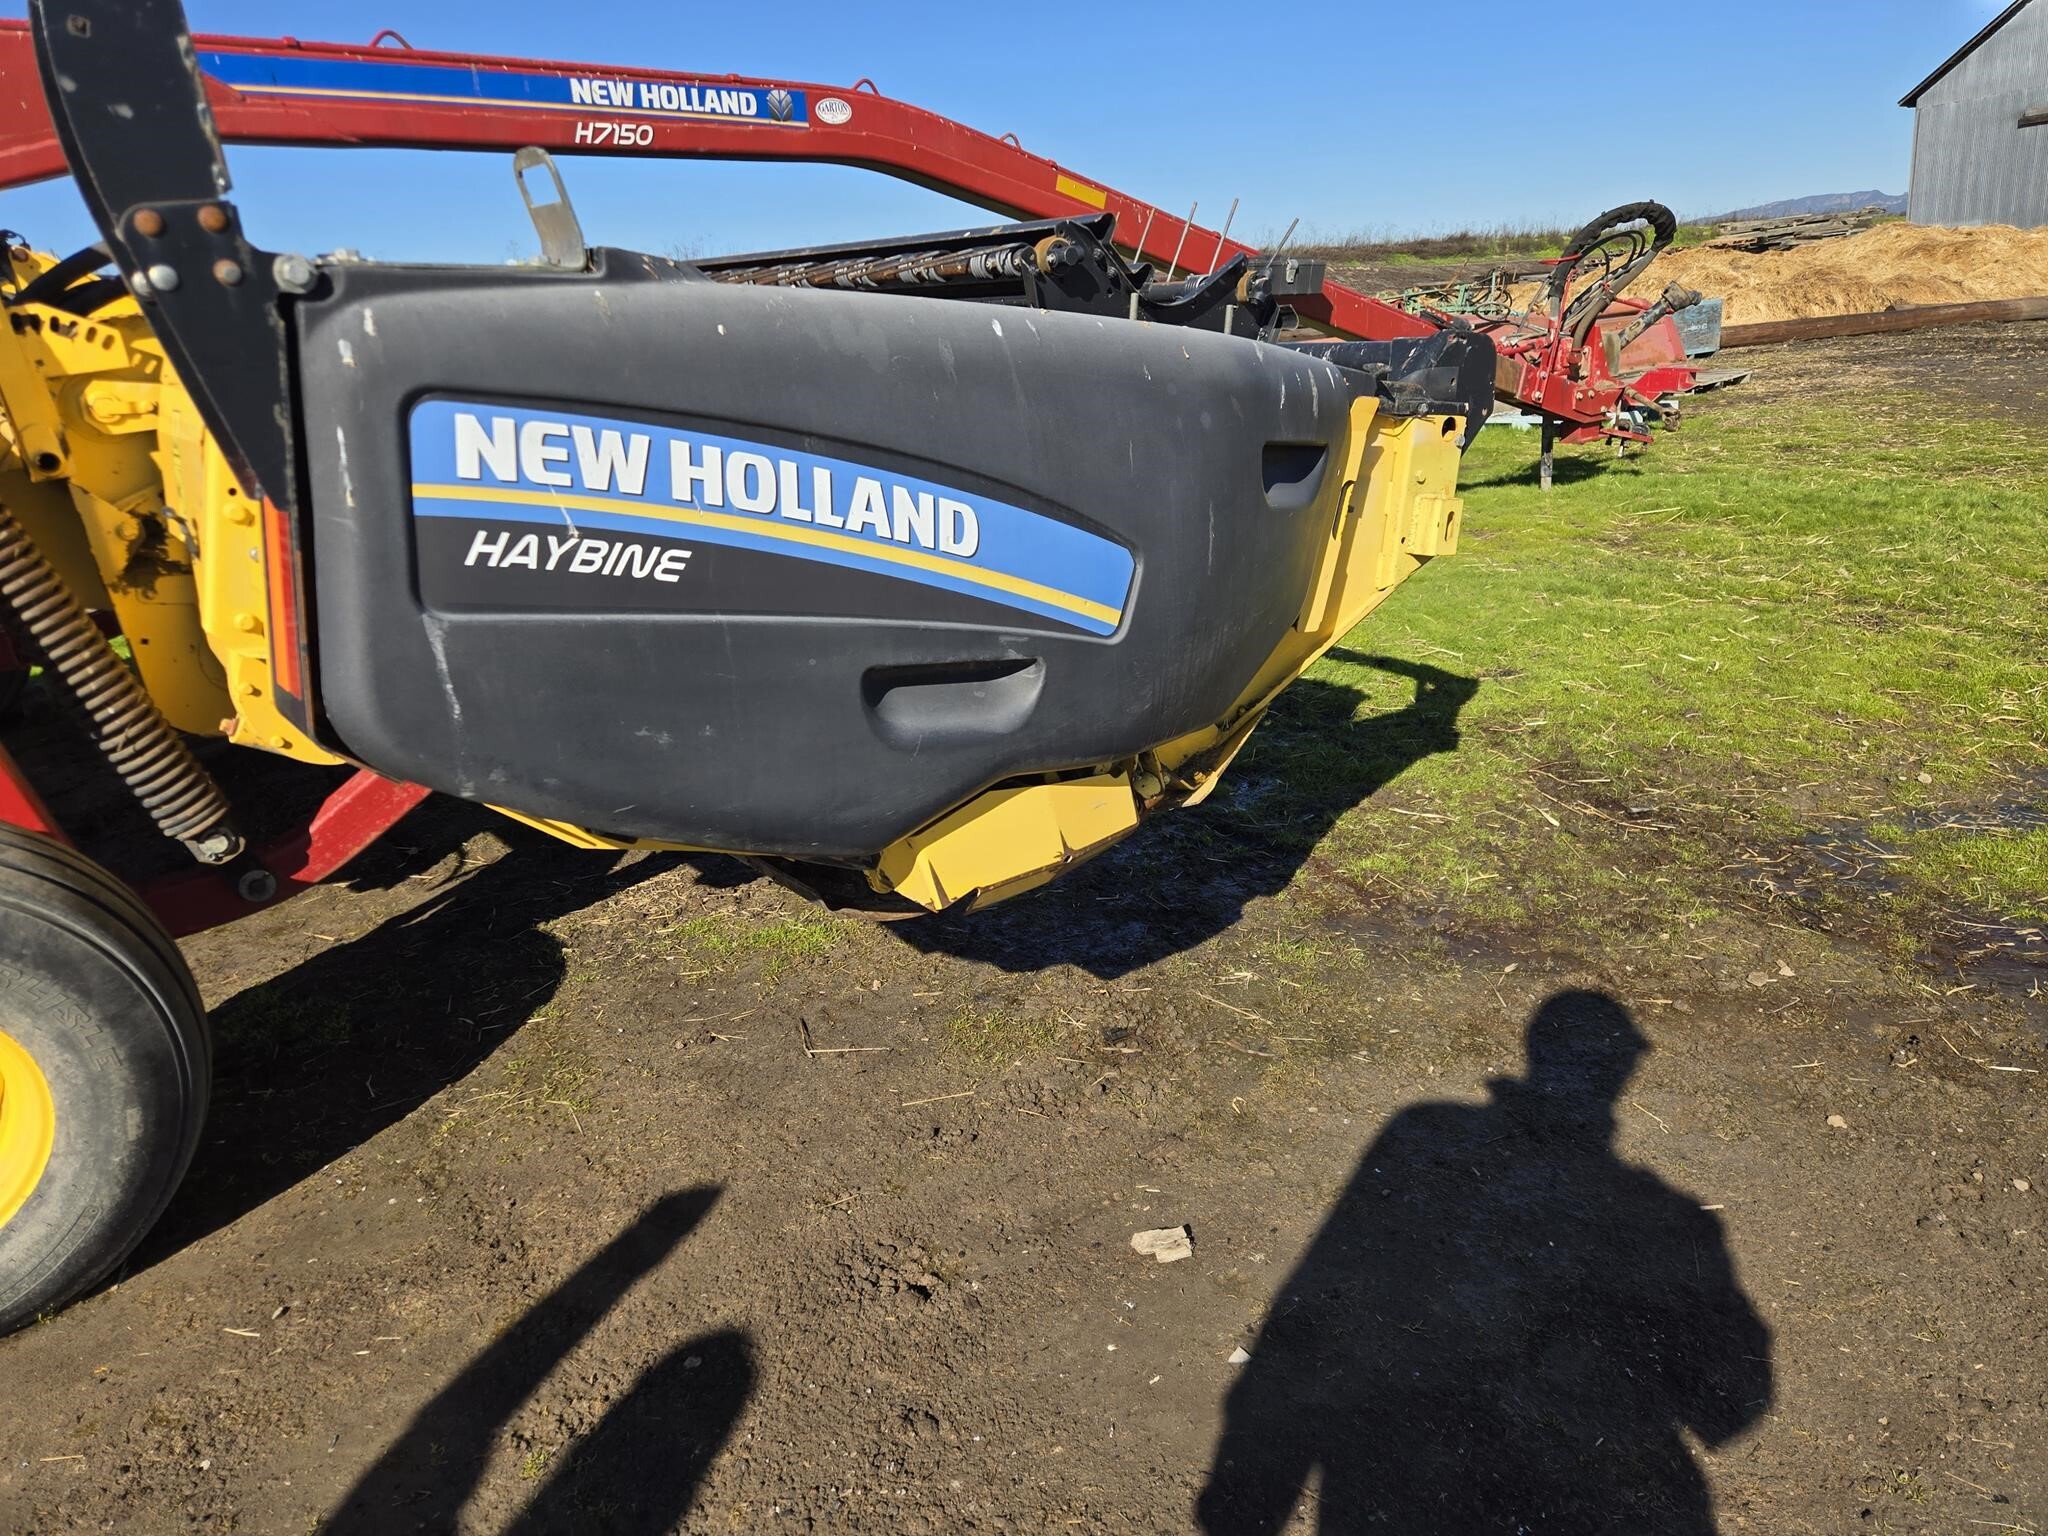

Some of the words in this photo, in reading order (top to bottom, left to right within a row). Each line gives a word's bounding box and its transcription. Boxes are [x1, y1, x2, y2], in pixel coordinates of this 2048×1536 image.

[570, 78, 633, 107] NEW
[640, 84, 757, 116] HOLLAND
[574, 121, 653, 146] H7150
[455, 412, 650, 495] NEW
[670, 439, 980, 558] HOLLAND
[464, 530, 692, 583] HAYBINE
